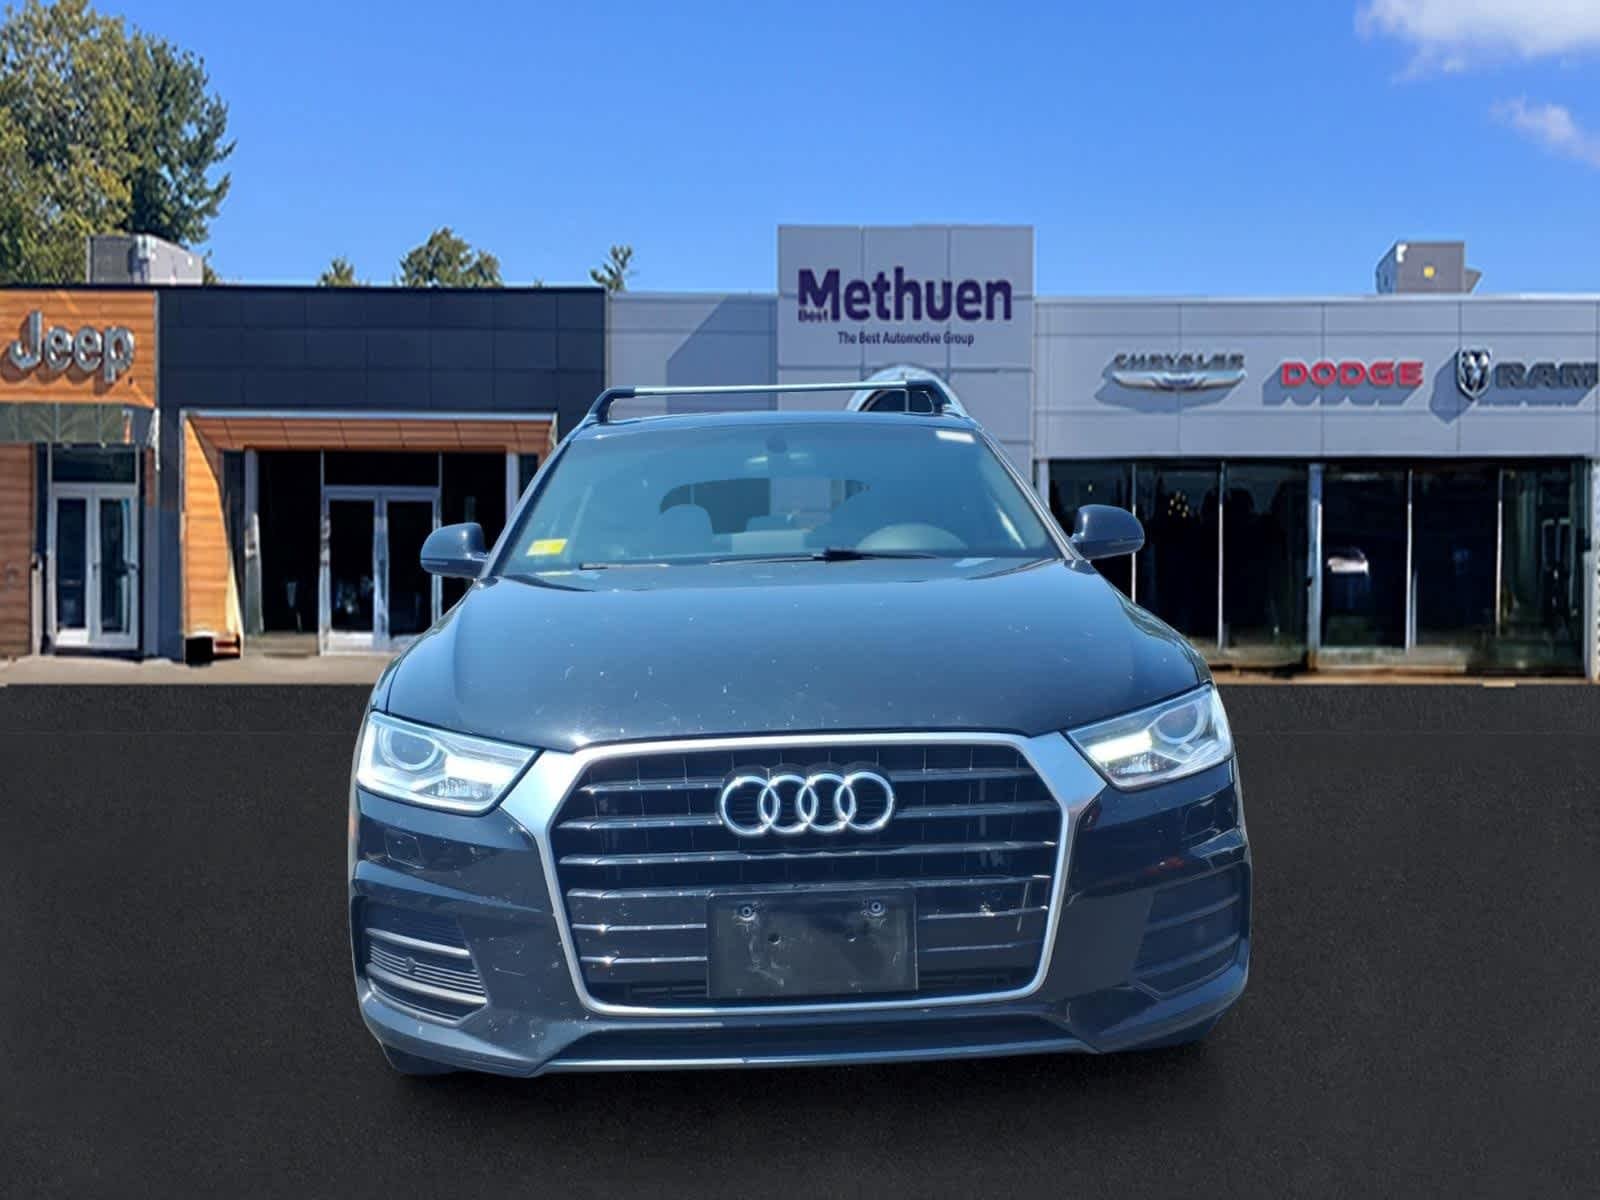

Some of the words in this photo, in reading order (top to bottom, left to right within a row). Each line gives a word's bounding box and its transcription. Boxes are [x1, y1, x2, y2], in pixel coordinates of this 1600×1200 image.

[798, 266, 1012, 321] Methuen
[9, 311, 135, 384] Jeep
[837, 331, 857, 344] The
[859, 331, 881, 344] Best
[882, 331, 941, 344] Automotive
[943, 331, 975, 347] Group
[1280, 361, 1424, 387] DODGE
[1494, 362, 1599, 389] RAM
